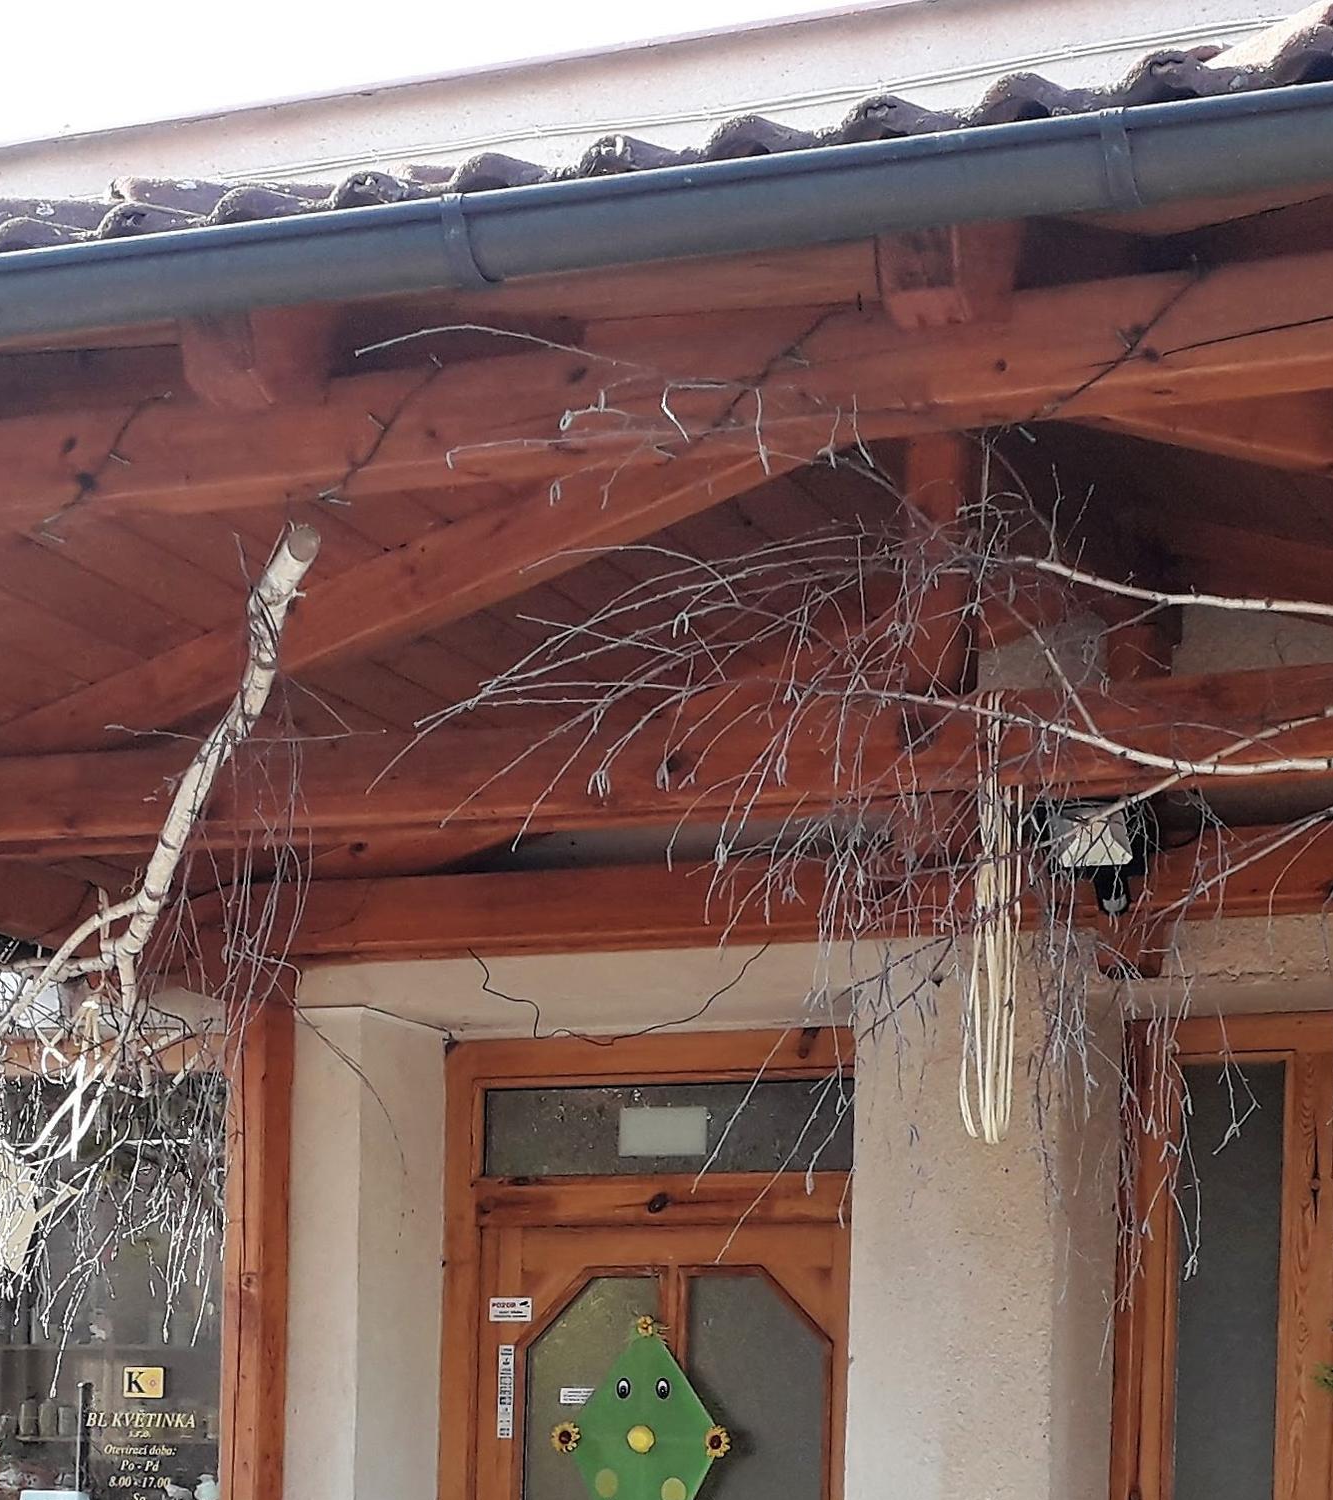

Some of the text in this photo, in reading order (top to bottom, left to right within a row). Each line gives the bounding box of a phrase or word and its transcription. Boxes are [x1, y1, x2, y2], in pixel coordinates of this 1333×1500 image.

[85, 1409, 196, 1428] BL KVĚTINKA
[120, 1459, 135, 1472] Po
[108, 1476, 132, 1488] 8.00
[142, 1476, 171, 1489] 17.00
